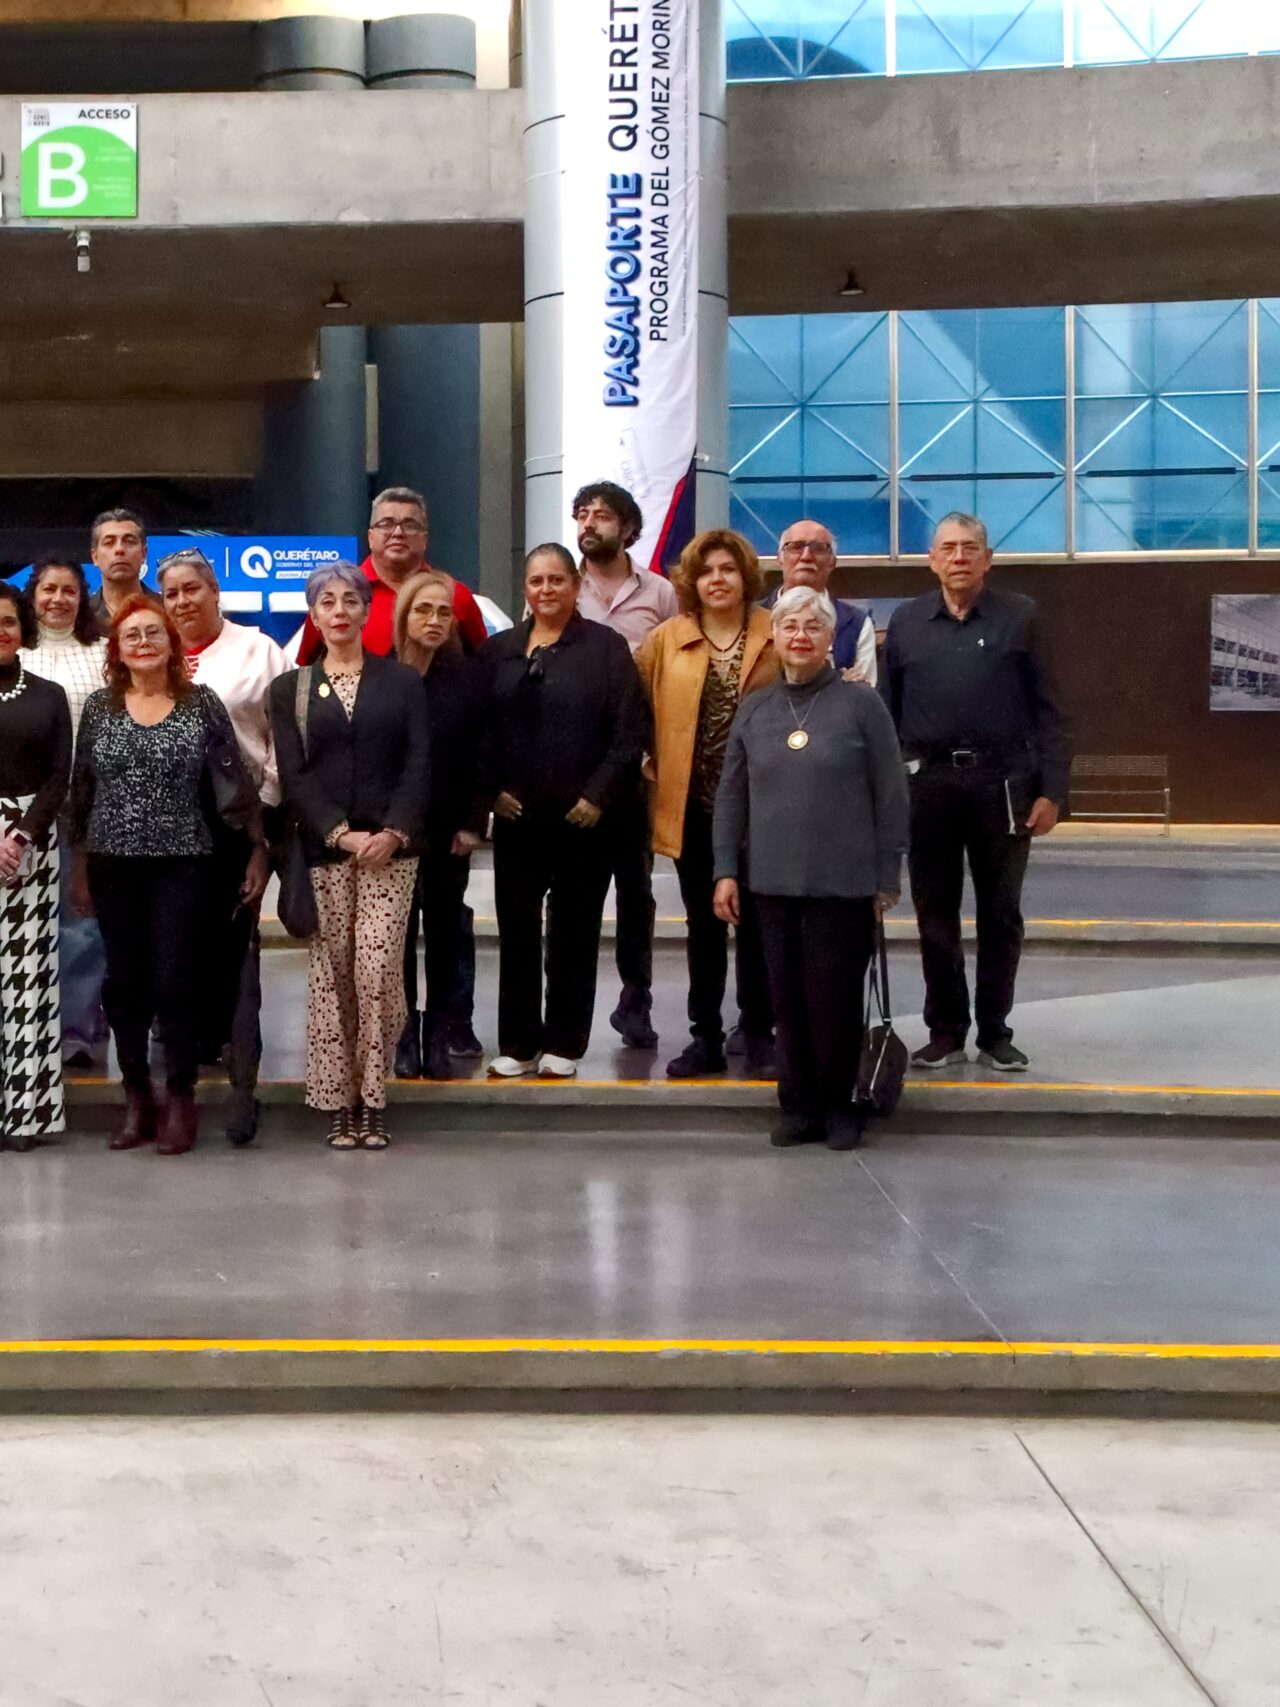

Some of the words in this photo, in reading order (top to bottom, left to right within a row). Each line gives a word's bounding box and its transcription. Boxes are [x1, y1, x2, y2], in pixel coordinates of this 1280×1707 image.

[78, 109, 131, 120] ACCESO
[646, 76, 670, 160] GÓMEZ
[38, 141, 89, 208] B
[651, 166, 669, 207] DEL
[603, 172, 642, 407] PASAPORTE
[649, 214, 669, 342] PROGRAMA
[273, 547, 339, 561] QUERÉTARO
